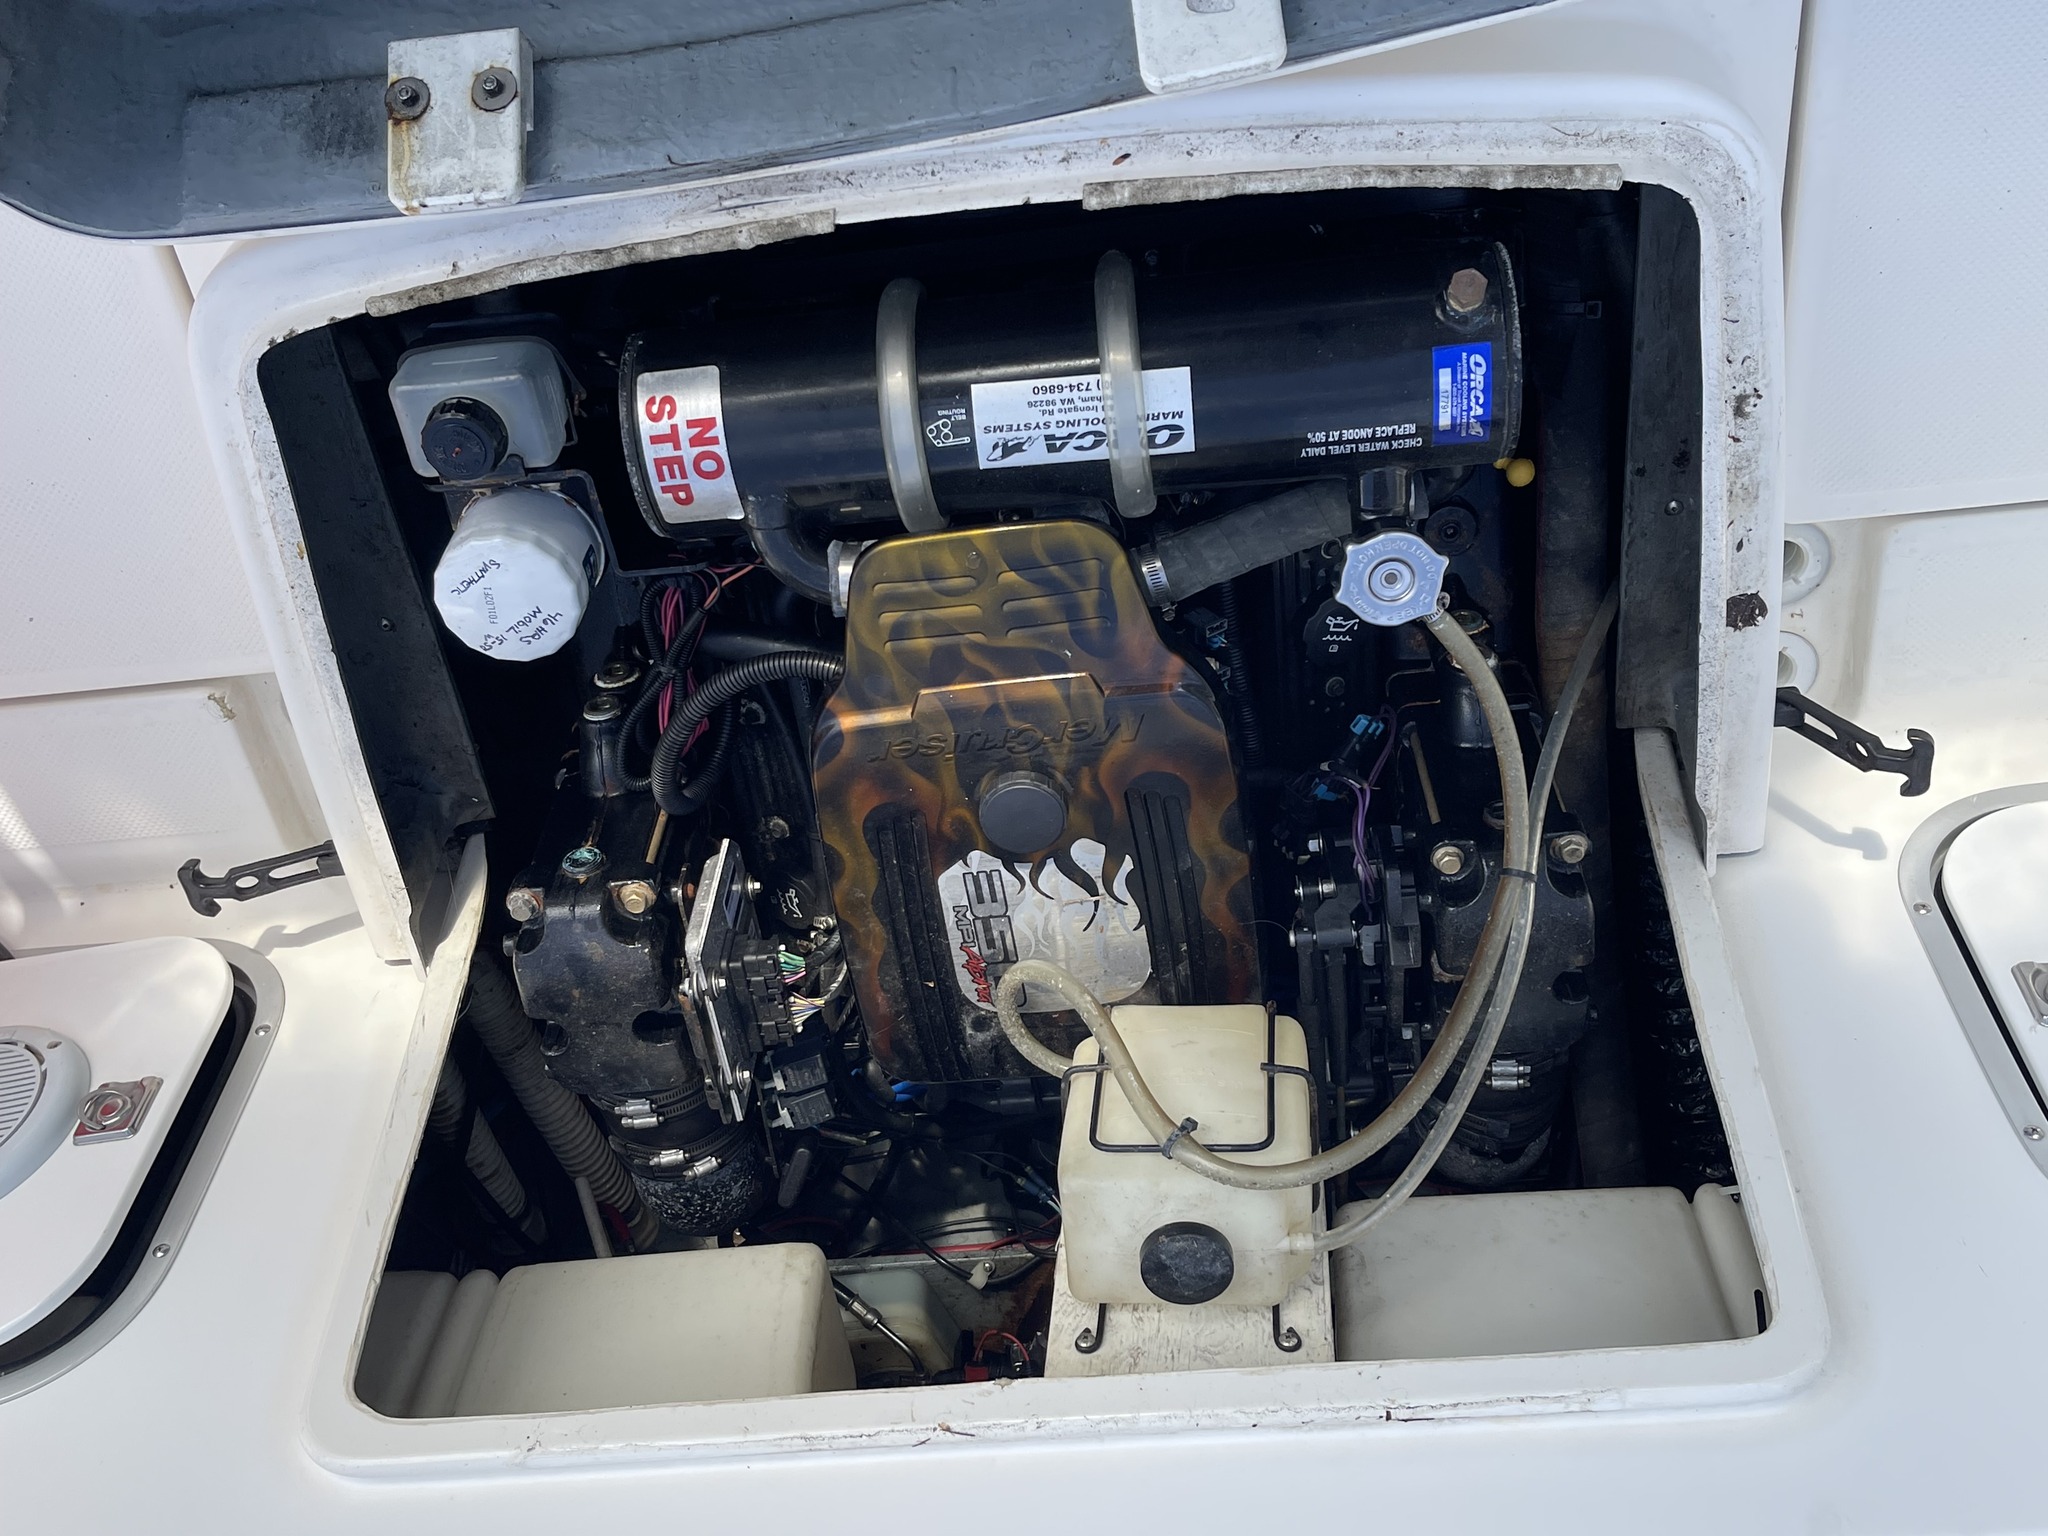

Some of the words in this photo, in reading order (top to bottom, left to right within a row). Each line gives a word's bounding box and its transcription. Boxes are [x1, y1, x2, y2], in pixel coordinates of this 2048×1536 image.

[1032, 382, 1092, 396] 734-6860
[1469, 354, 1487, 416] ORCA
[1027, 399, 1056, 408] 98226
[1059, 397, 1075, 406] WA
[1441, 390, 1449, 414] 17791
[937, 408, 966, 416] ROUTING
[1039, 408, 1055, 416] Rd.
[1058, 405, 1098, 416] Irongate
[983, 421, 1052, 435] SYSTEMS
[1342, 428, 1373, 440] ANODE
[1375, 423, 1416, 438] REPLACE
[1044, 424, 1185, 455] OCA
[1307, 431, 1326, 443] 50%
[1328, 431, 1340, 442] AT
[686, 416, 725, 480] NO
[1328, 443, 1356, 454] LEVEL
[1358, 440, 1389, 452] WATER
[1391, 437, 1423, 449] CHECK
[644, 395, 695, 506] STEP
[1300, 446, 1326, 458] DAILY
[866, 716, 1143, 765] MerCruiser
[953, 905, 977, 947] MPI
[958, 945, 994, 1004] Alpha
